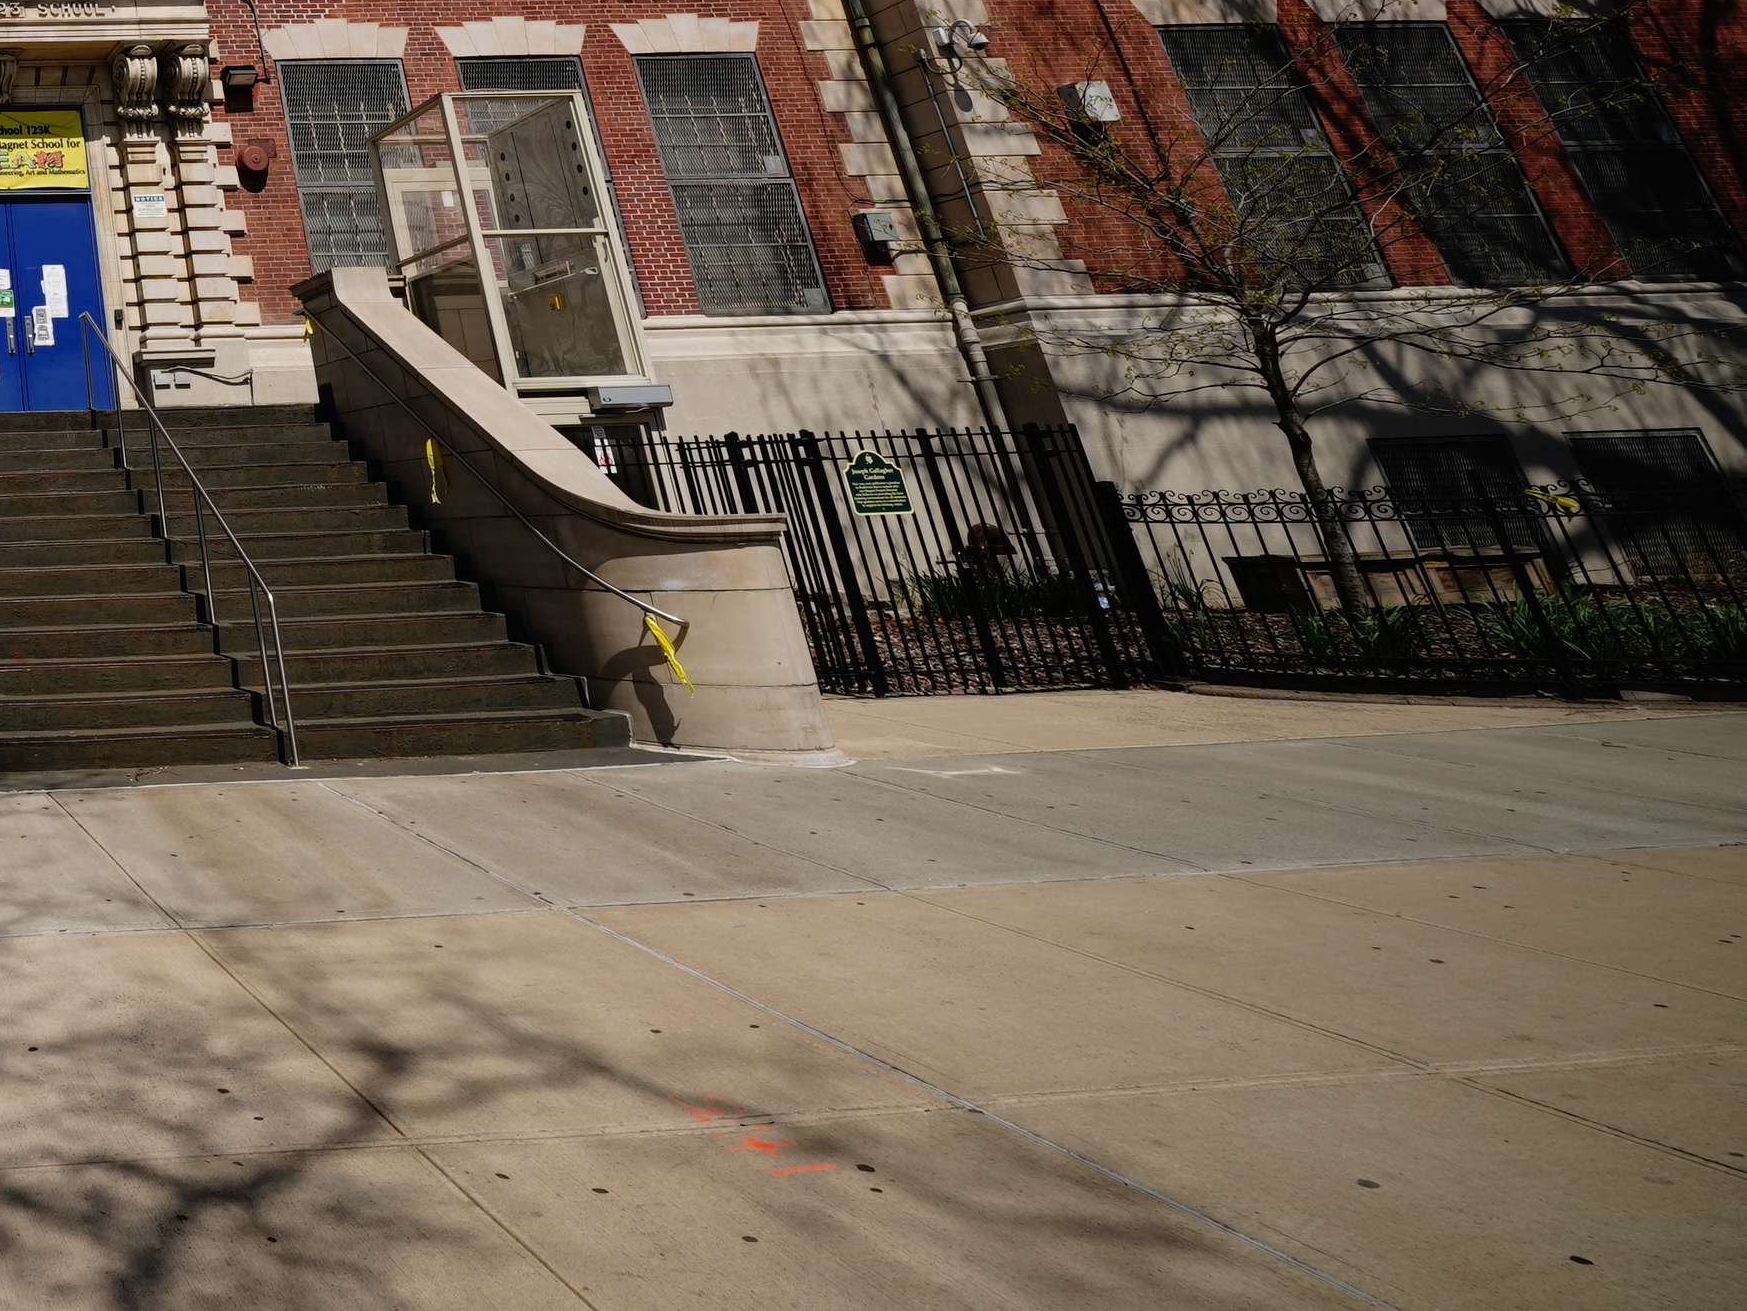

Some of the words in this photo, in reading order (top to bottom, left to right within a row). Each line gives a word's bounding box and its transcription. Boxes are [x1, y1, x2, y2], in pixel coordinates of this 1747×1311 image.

[37, 2, 106, 18] SCHOOL
[25, 124, 51, 135] 123K
[31, 138, 63, 149] School
[67, 137, 81, 148] for
